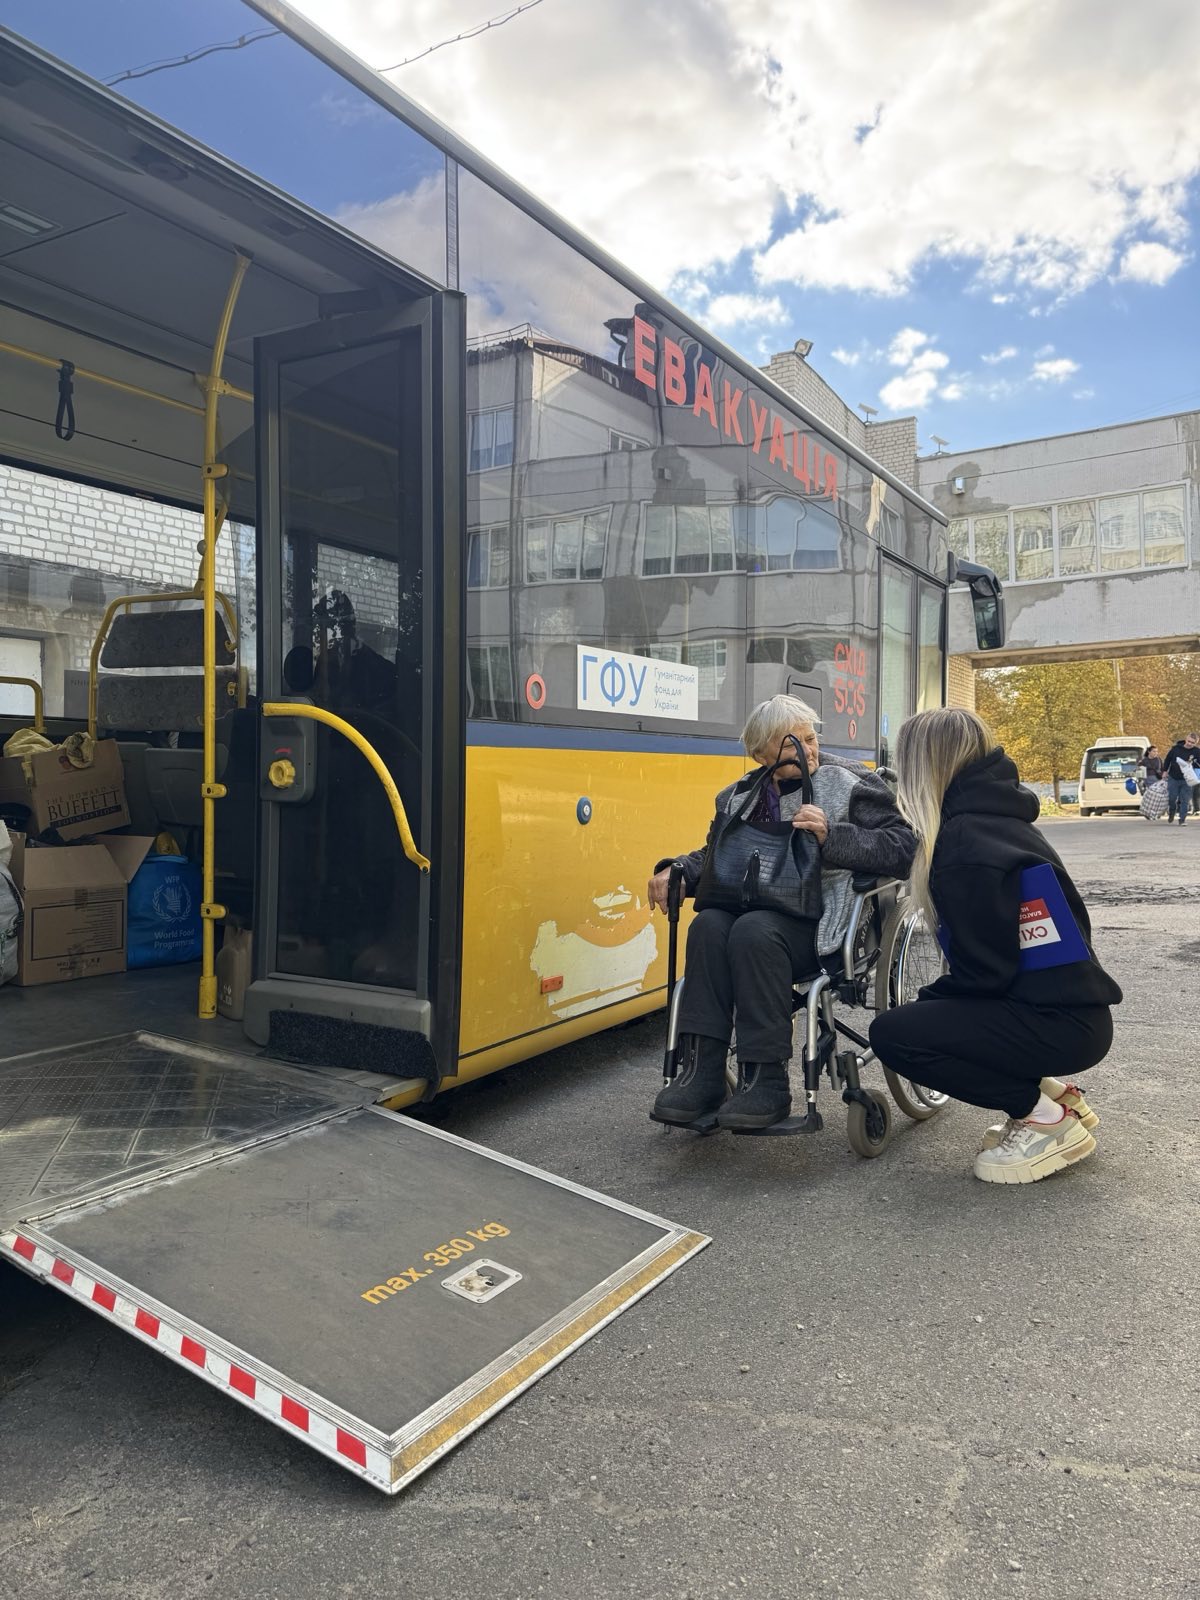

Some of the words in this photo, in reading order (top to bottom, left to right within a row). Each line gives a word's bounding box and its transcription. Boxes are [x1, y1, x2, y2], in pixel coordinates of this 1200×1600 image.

[634, 315, 838, 502] ЕВАКУАЦІЯ
[834, 643, 865, 676] СХІД
[583, 654, 647, 707] ГФУ
[654, 667, 695, 684] Гуманітарний
[654, 682, 670, 696] фонд
[671, 688, 682, 697] для
[834, 677, 865, 717] SOS
[654, 698, 679, 711] України
[47, 789, 120, 820] BUFFETT
[165, 875, 180, 884] WFP
[154, 929, 178, 940] World
[180, 926, 195, 937] Food
[1020, 926, 1048, 941] СХІ
[154, 939, 195, 950] Programme
[360, 1267, 434, 1304] max.
[423, 1238, 476, 1267] 350
[466, 1222, 511, 1242] kg
